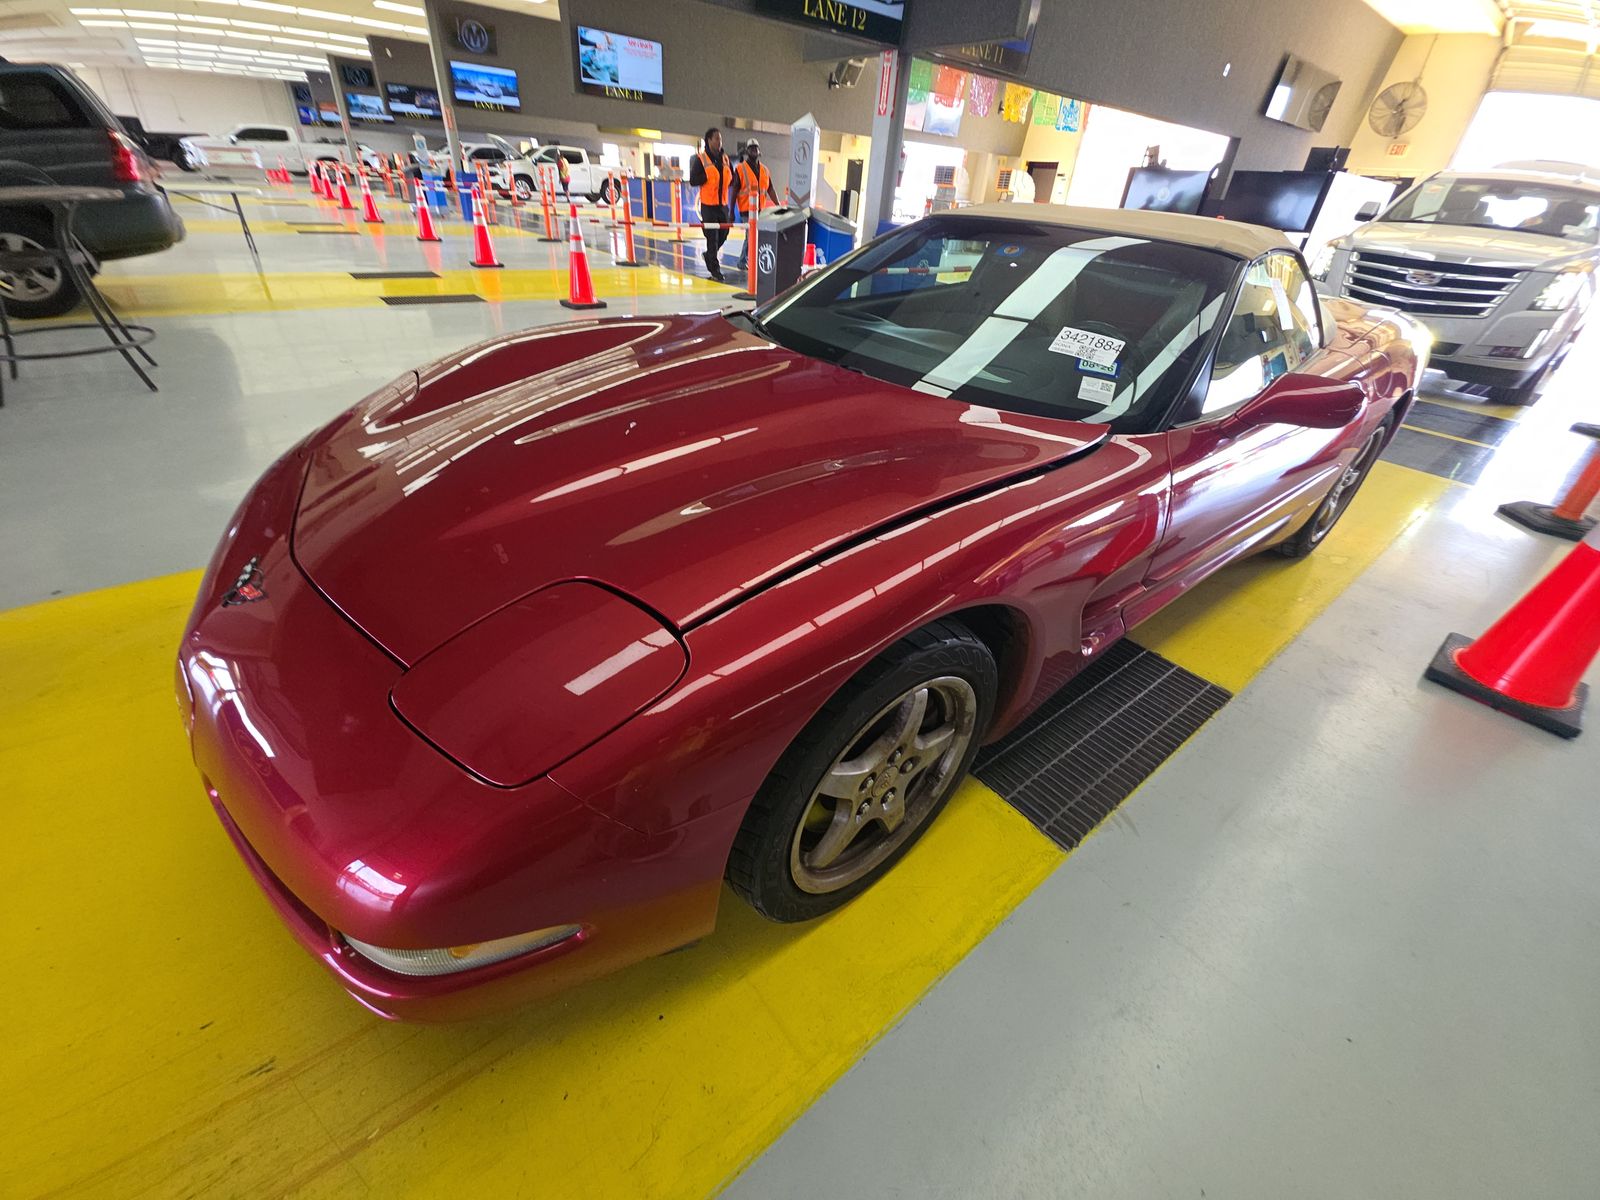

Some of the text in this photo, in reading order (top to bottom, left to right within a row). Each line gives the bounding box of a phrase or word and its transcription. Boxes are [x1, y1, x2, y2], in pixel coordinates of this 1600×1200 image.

[803, 0, 867, 31] LANE 12
[993, 45, 1004, 65] 11
[604, 84, 644, 101] LANE 13
[1060, 330, 1122, 354] 3421884
